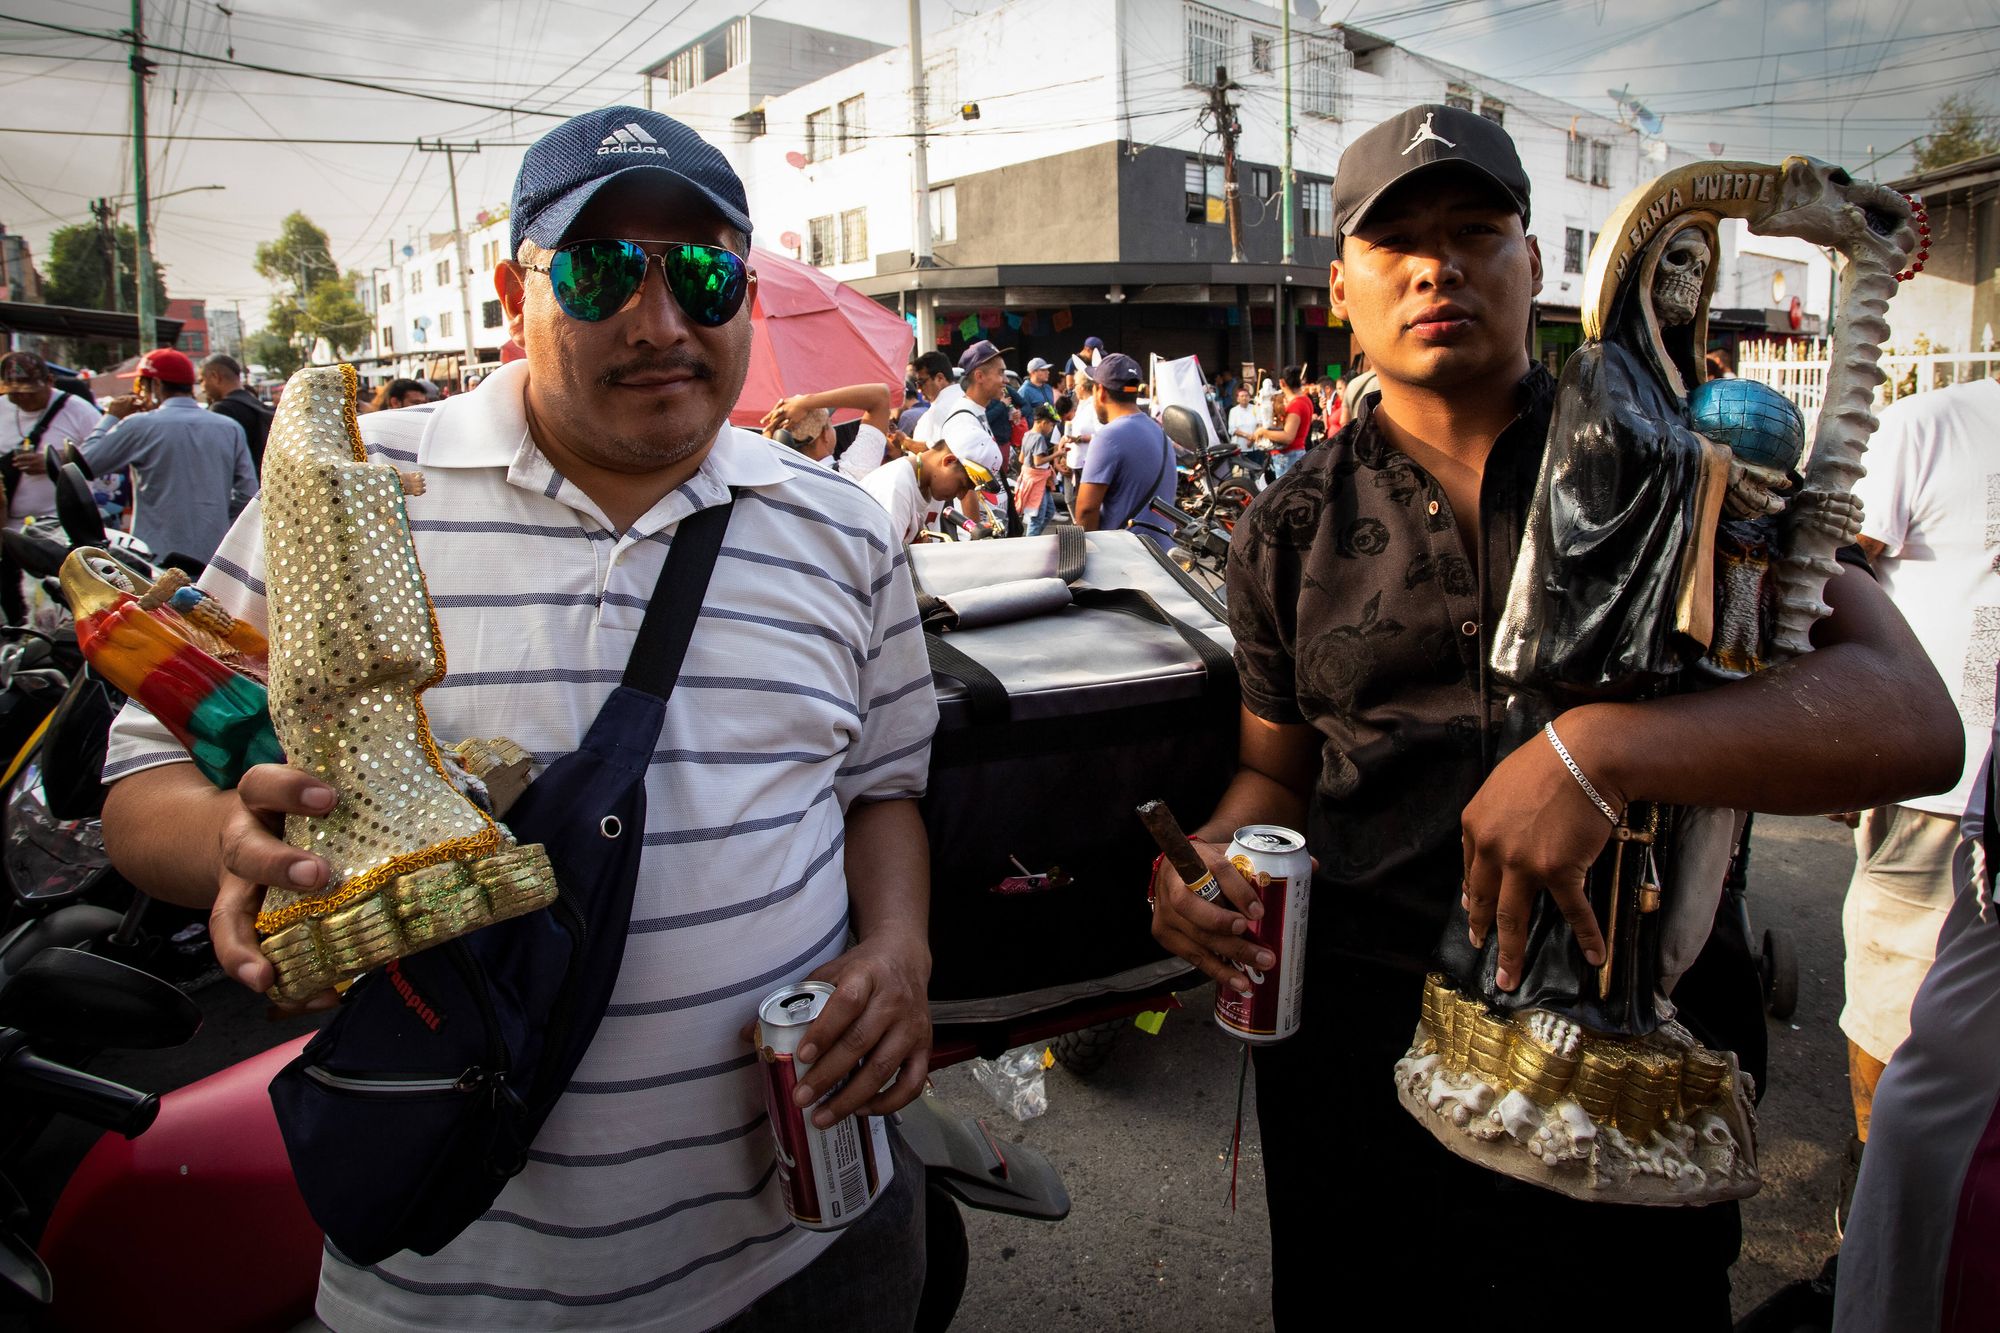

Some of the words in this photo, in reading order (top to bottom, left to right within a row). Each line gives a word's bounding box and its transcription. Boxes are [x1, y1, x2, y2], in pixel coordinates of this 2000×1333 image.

[597, 142, 667, 156] adidas
[1629, 188, 1684, 251] SANTA
[1694, 173, 1775, 202] MUERTE
